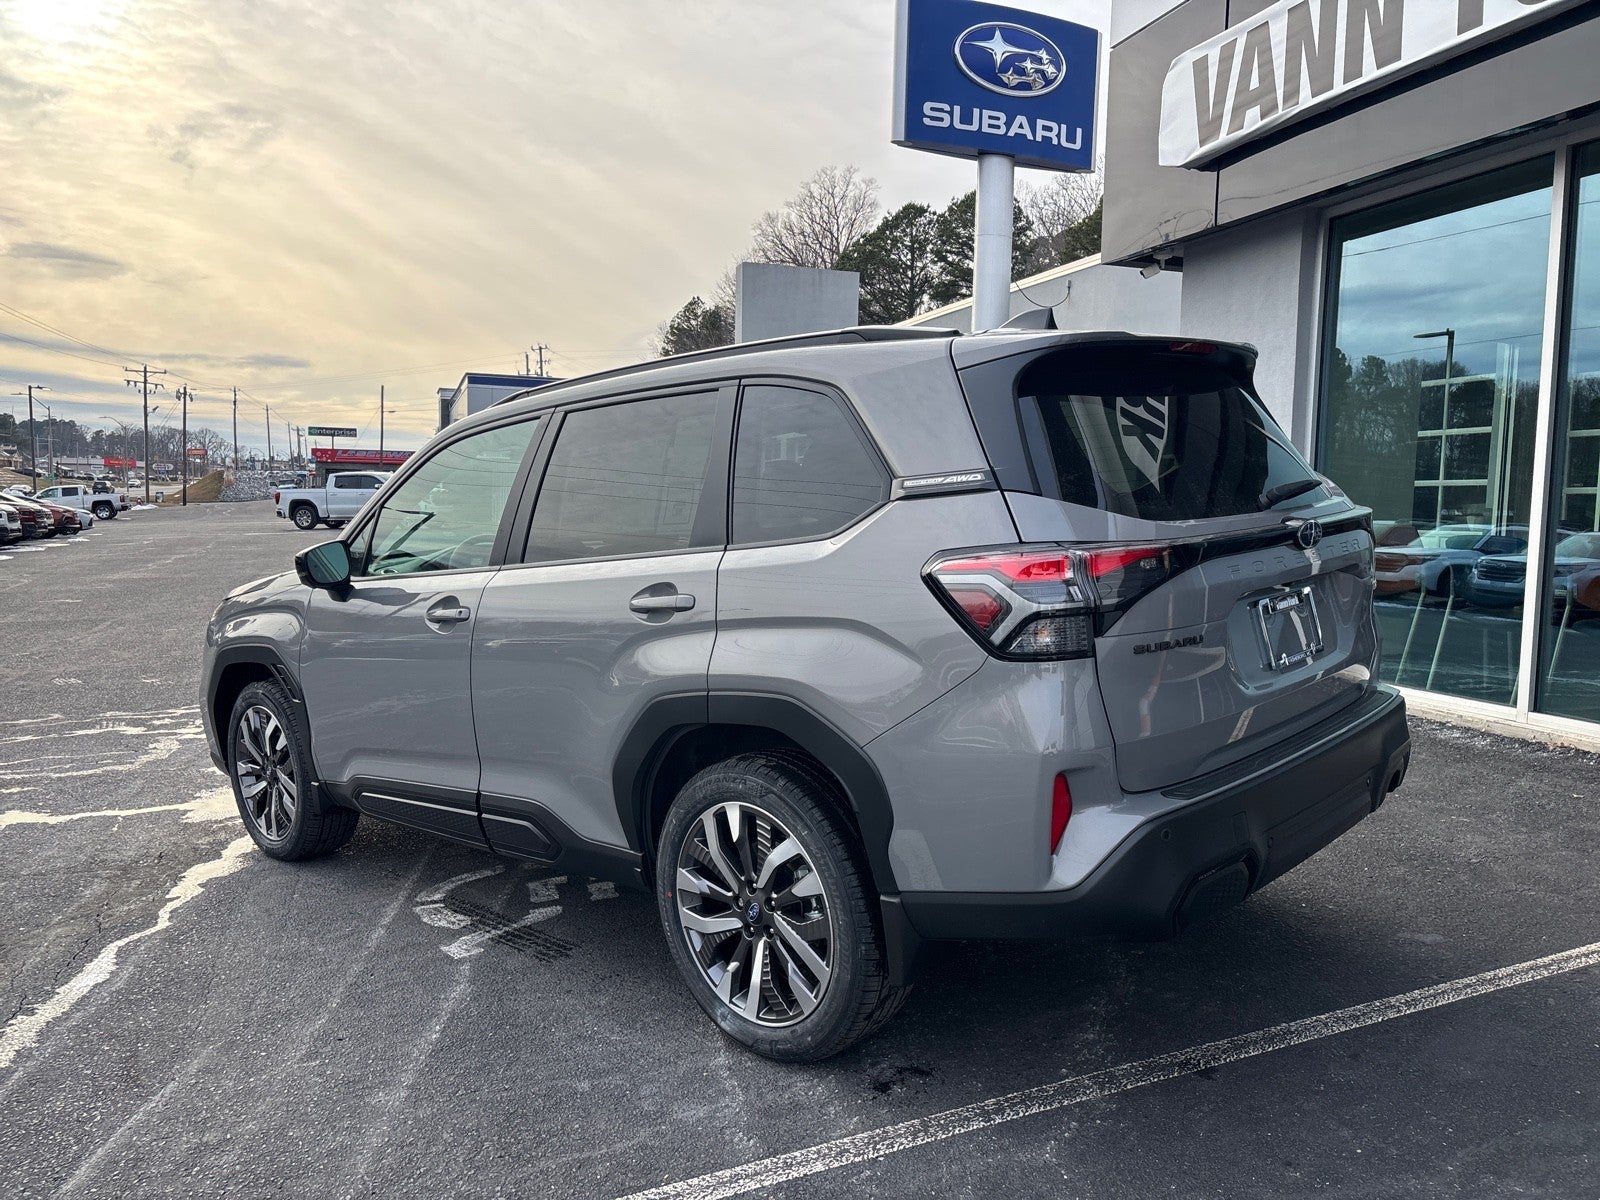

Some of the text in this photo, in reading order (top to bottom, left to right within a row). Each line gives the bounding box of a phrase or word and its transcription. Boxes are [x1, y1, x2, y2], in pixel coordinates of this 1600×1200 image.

[1192, 0, 1403, 148] VANN
[922, 101, 1083, 150] SUBARU
[311, 428, 356, 436] enterprise
[943, 474, 982, 483] AWD
[1226, 538, 1361, 580] FORESTER
[1133, 635, 1204, 655] SUBARU
